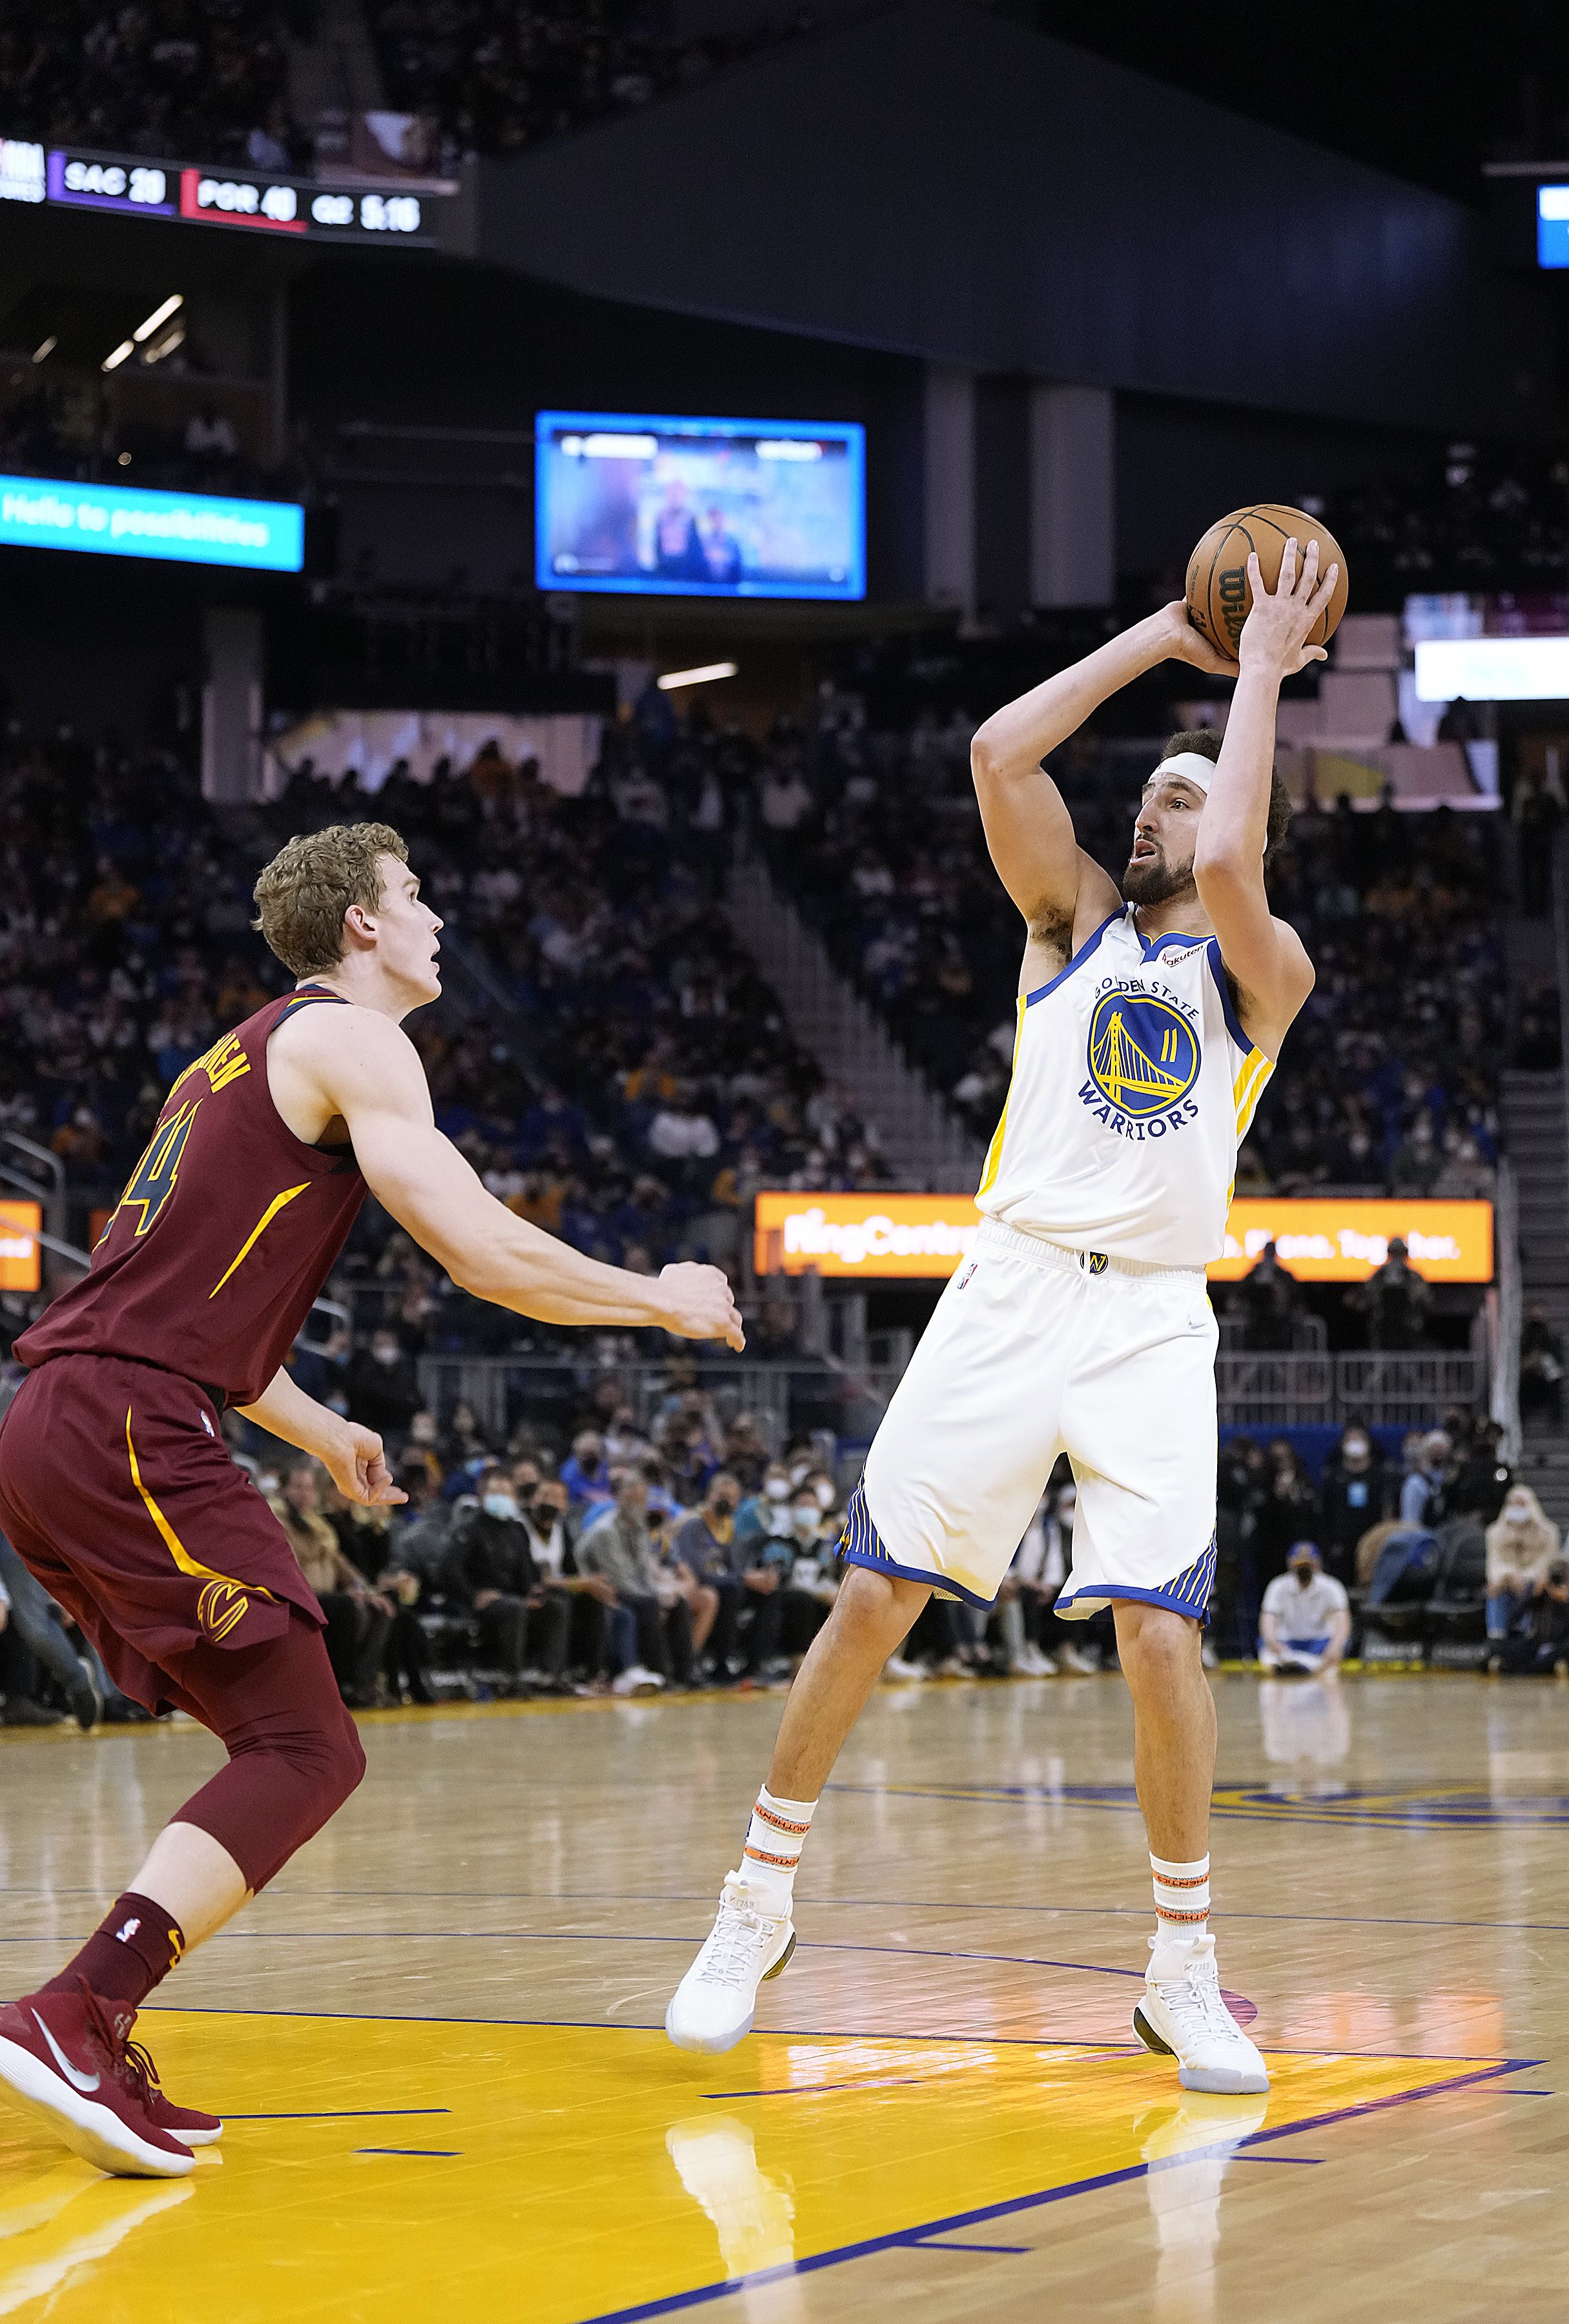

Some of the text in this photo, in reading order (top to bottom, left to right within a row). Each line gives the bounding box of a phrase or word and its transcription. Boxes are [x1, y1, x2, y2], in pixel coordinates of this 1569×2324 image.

[1162, 945, 1204, 967] Rakuten
[1151, 981, 1200, 1019] STATE
[1160, 1028, 1178, 1063] 11
[1078, 1079, 1199, 1141] WARRIORS
